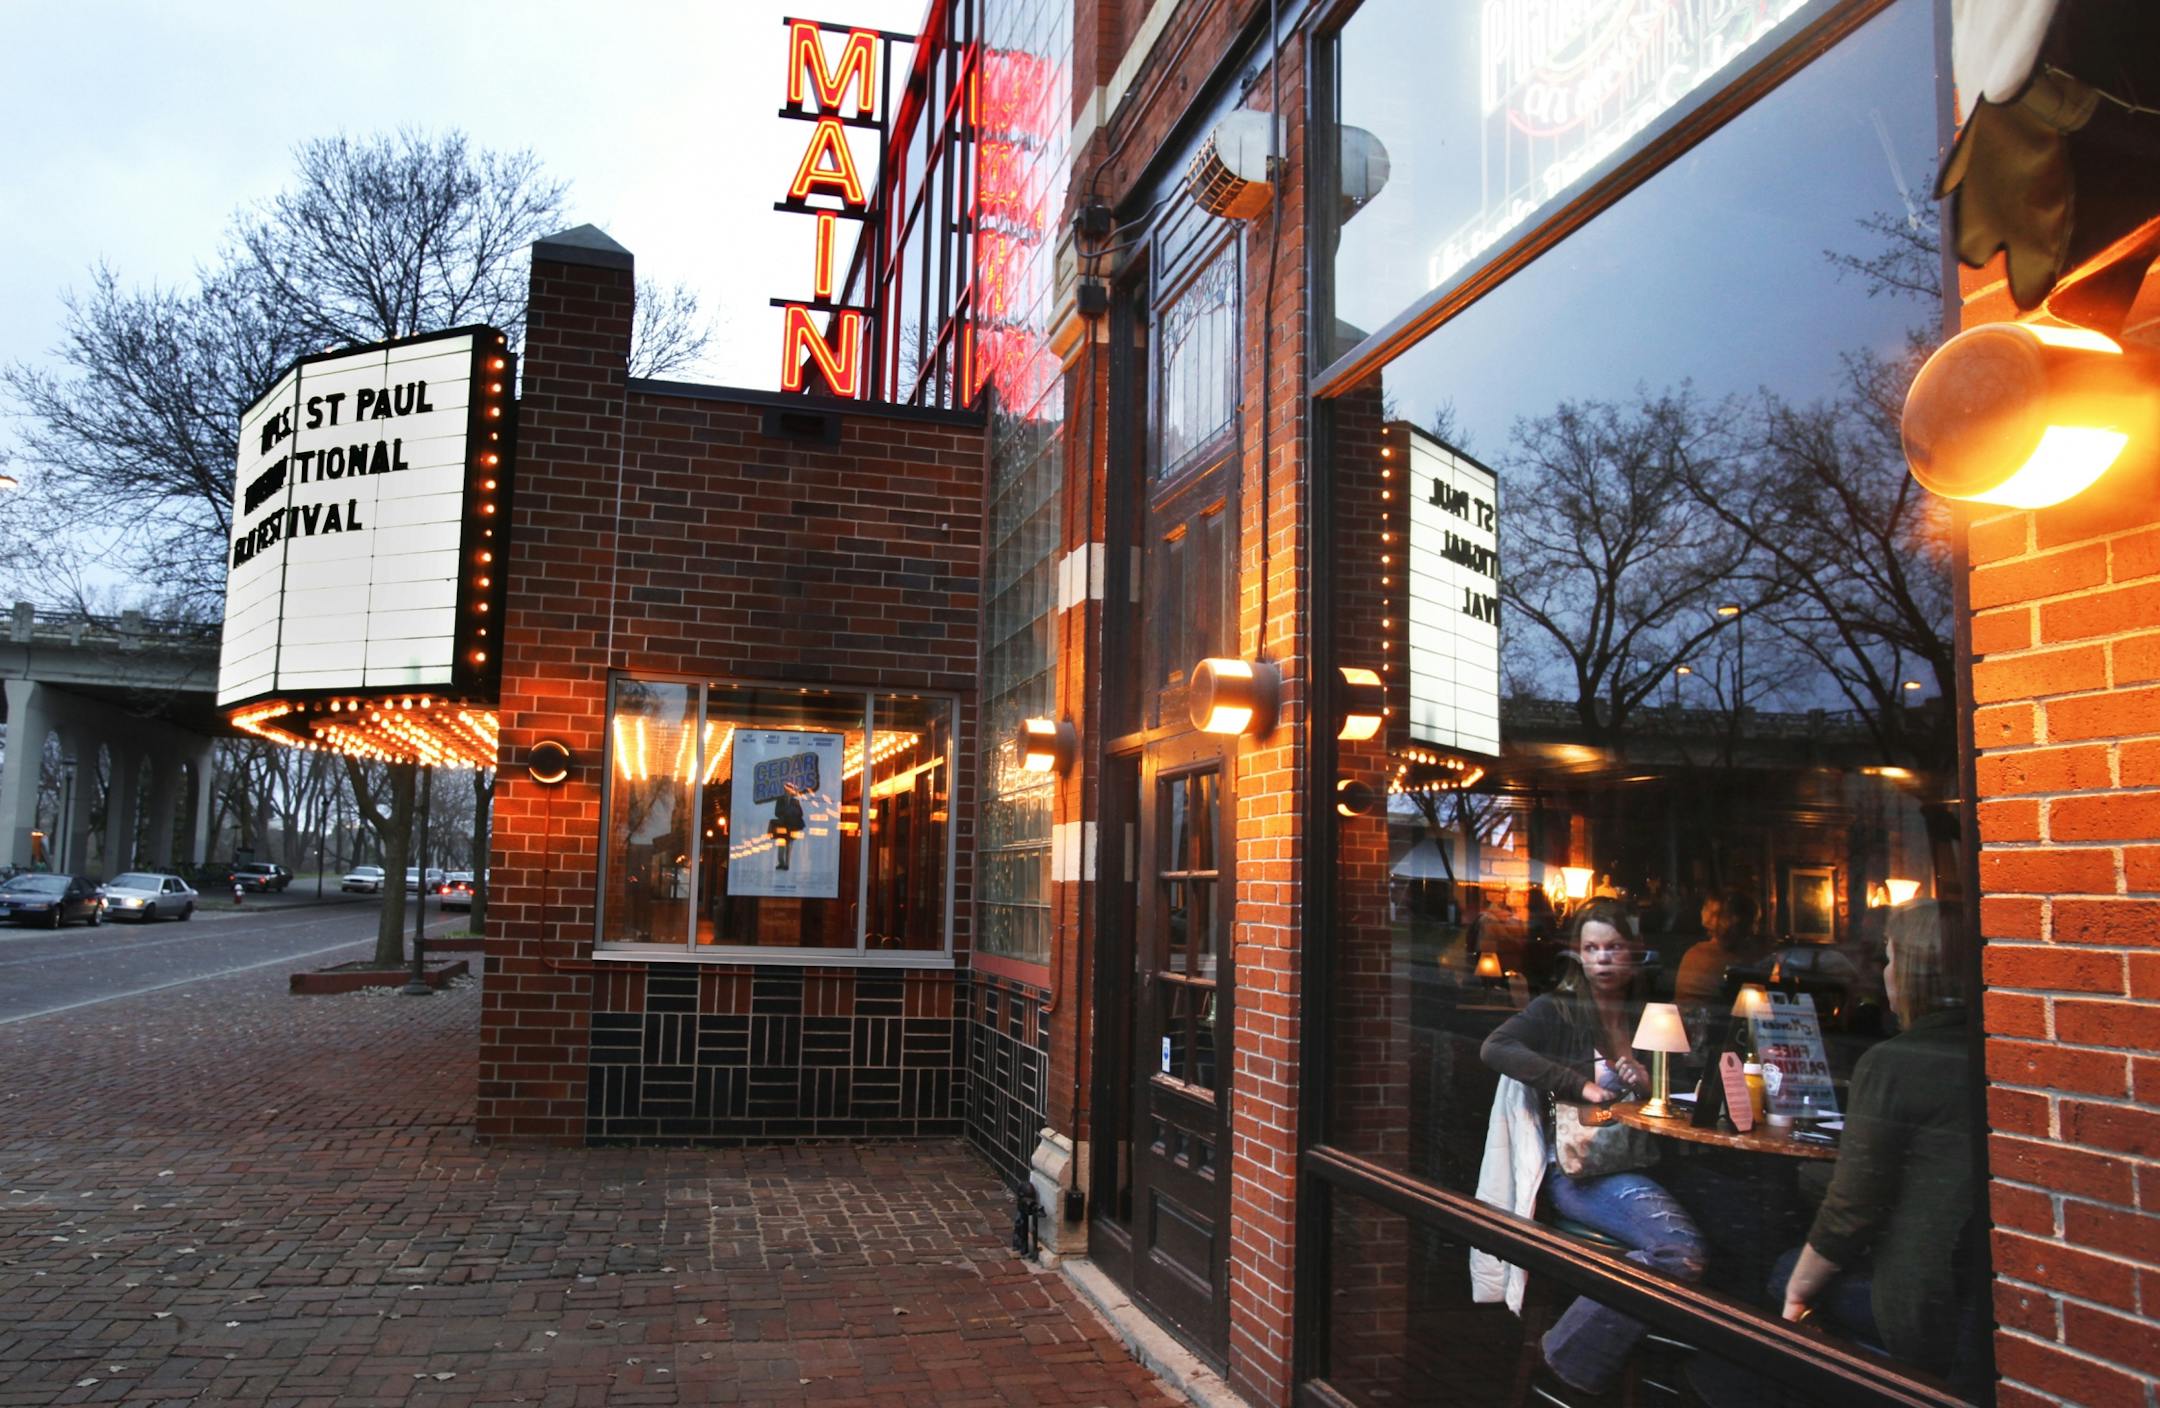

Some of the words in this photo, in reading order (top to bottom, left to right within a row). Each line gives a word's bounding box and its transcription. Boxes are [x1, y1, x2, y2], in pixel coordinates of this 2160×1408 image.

[781, 18, 880, 397] MAIN
[306, 393, 346, 430] ST
[356, 380, 434, 422] PAUL
[756, 754, 815, 782] CEDAR
